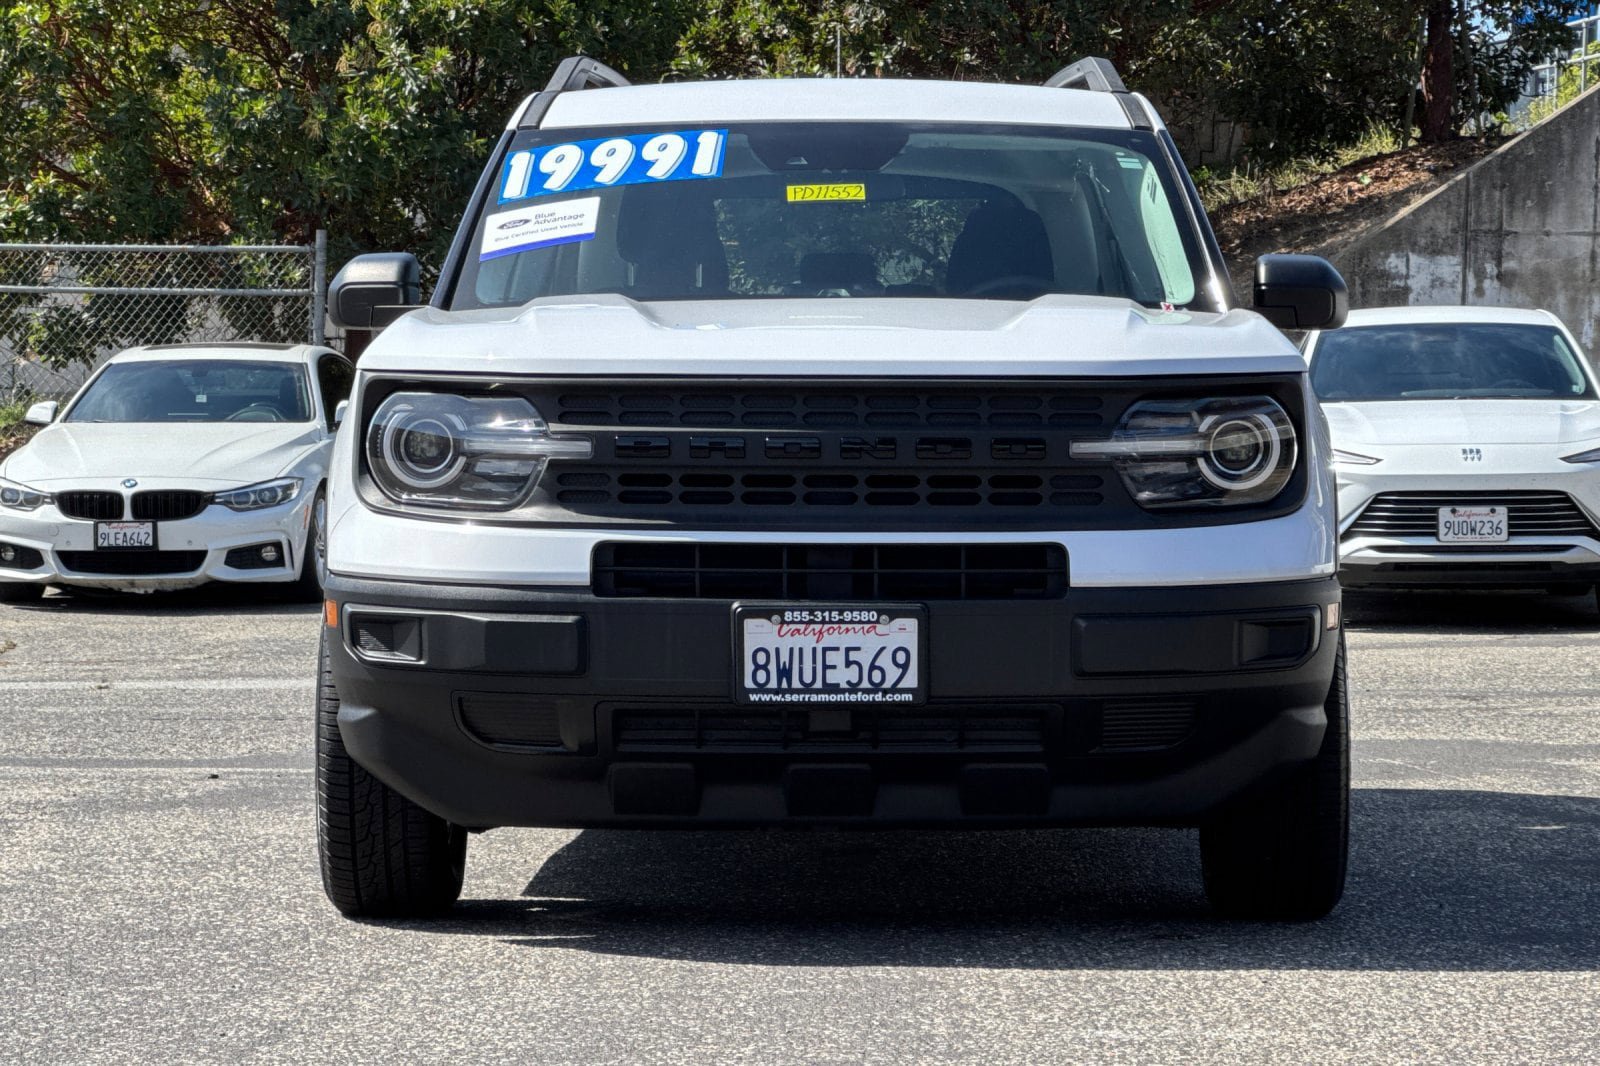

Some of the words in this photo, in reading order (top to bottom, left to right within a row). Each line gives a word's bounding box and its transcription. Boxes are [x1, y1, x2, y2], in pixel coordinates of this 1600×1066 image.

[502, 130, 724, 199] 19991
[793, 185, 863, 200] PD11552
[533, 213, 585, 226] Advantage
[534, 211, 556, 220] Blue
[511, 229, 539, 239] Certified
[615, 436, 1047, 459] BRONCO
[100, 532, 150, 546] 9LEA642
[784, 611, 878, 622] 855-315-9580
[777, 623, 890, 644] California
[751, 646, 911, 689] 8WUE569
[749, 691, 913, 702] www.serramonteford.com
